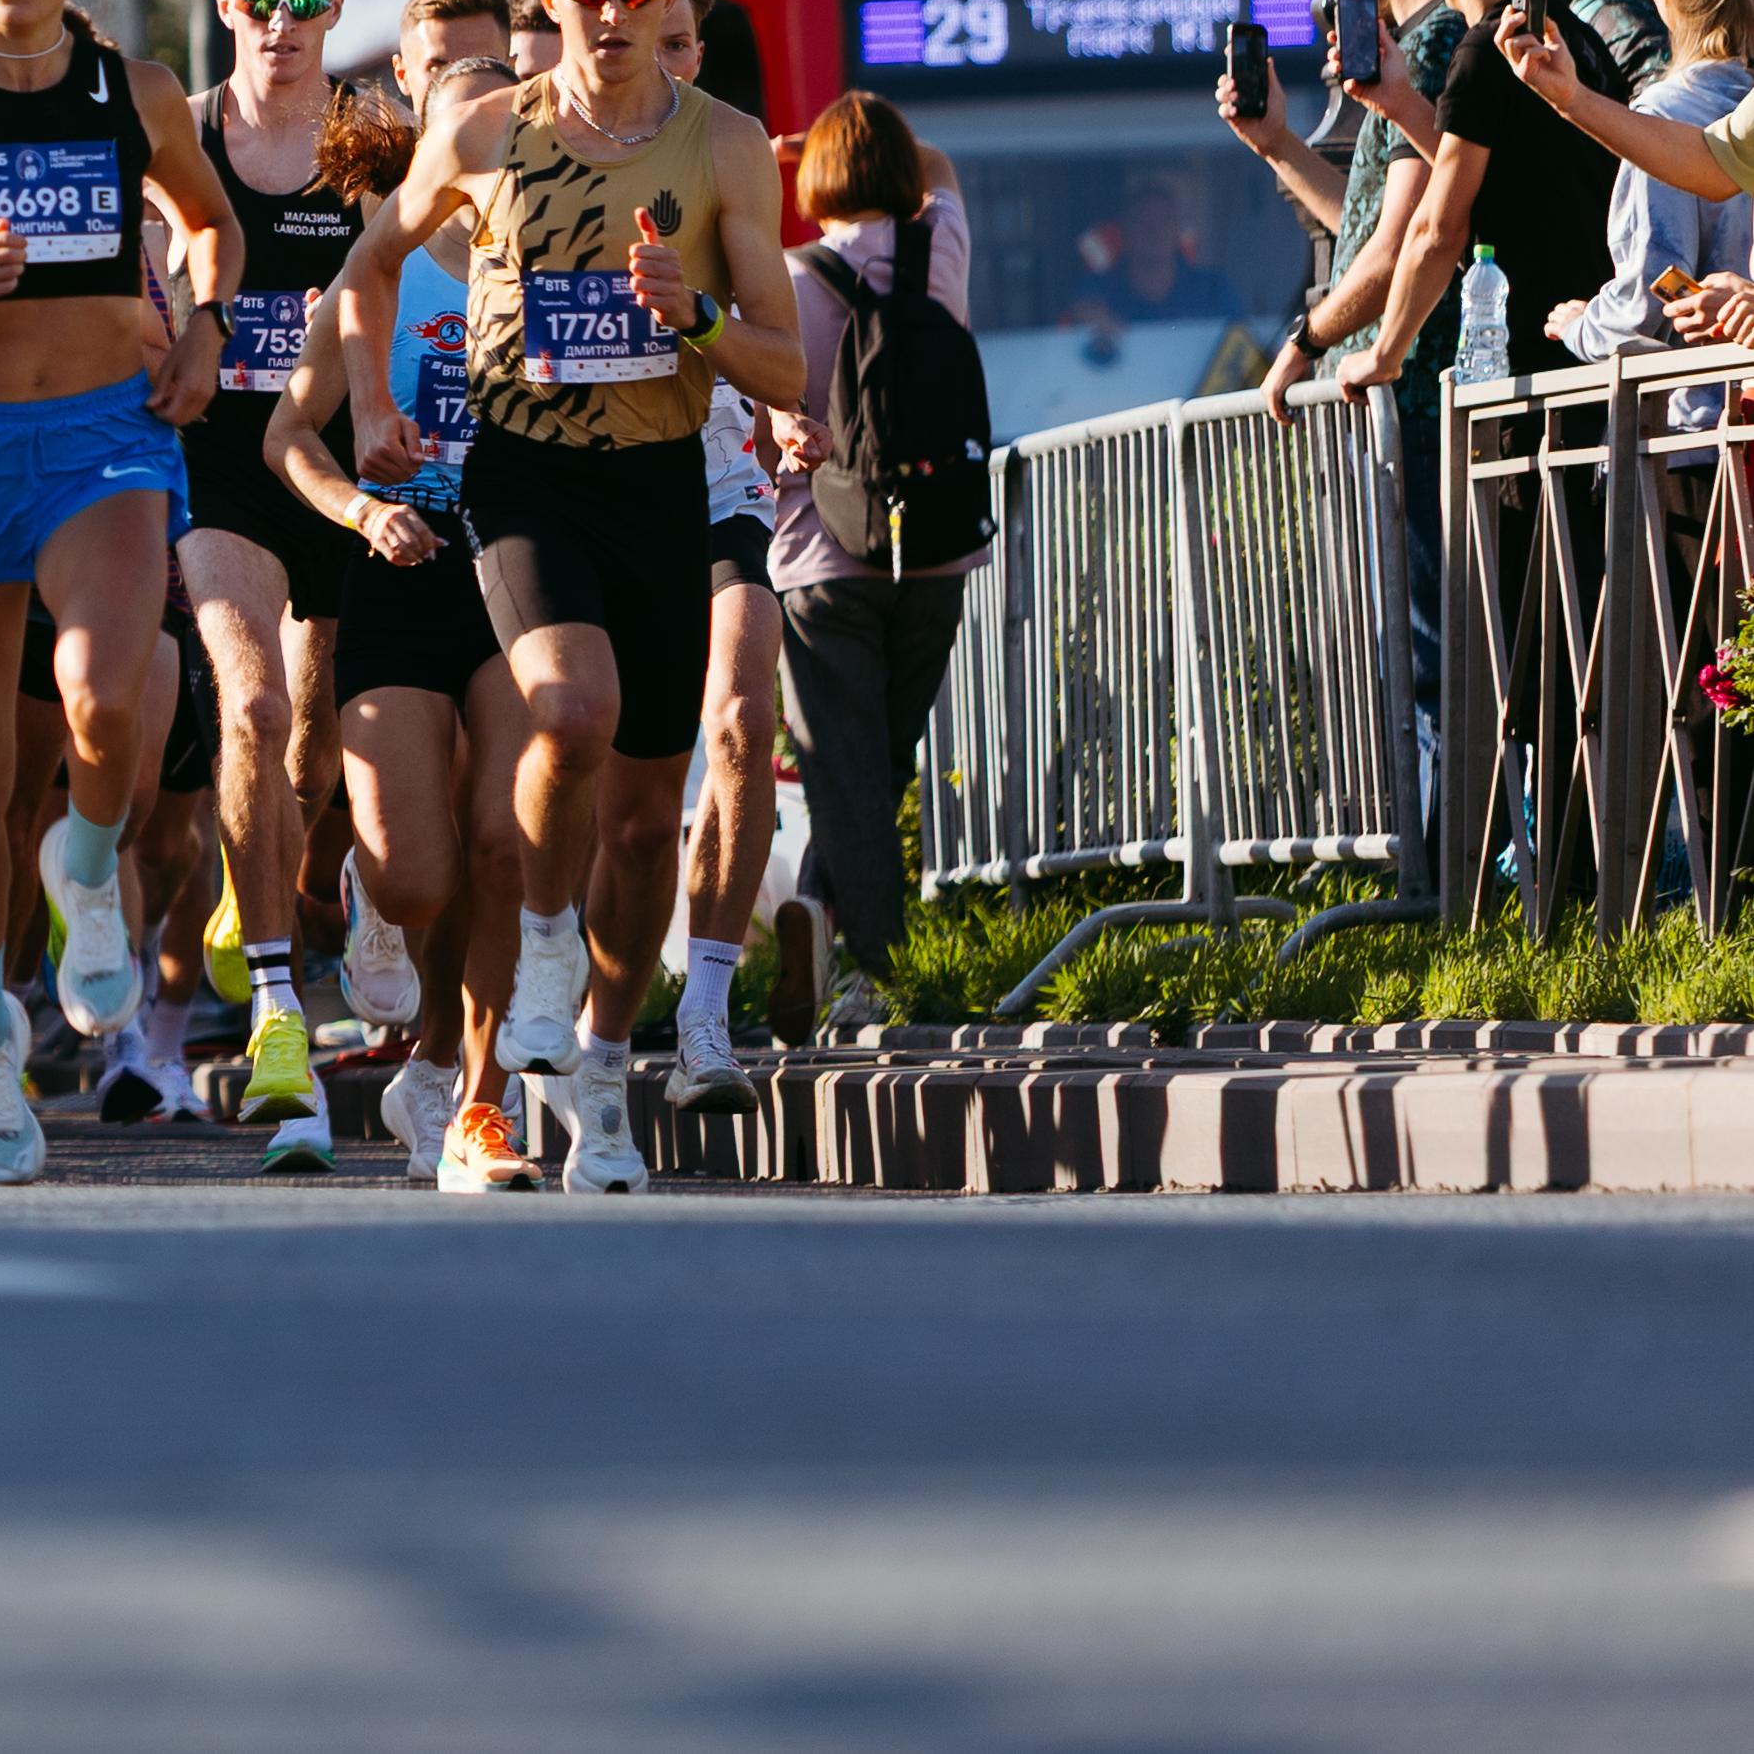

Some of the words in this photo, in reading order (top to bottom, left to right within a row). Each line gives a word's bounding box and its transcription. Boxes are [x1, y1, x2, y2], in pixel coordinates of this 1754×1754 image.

[284, 211, 340, 224] МАГАЗИНЫ
[11, 221, 67, 233] НИГИНА
[273, 223, 316, 236] LAMODA
[318, 226, 351, 237] SPORT
[545, 279, 570, 292] ВТБ
[243, 297, 265, 309] ВТБ
[546, 312, 629, 341] 17761
[252, 328, 306, 354] 753
[564, 343, 630, 358] ДМИТРИЙ
[442, 364, 466, 378] ВТБ
